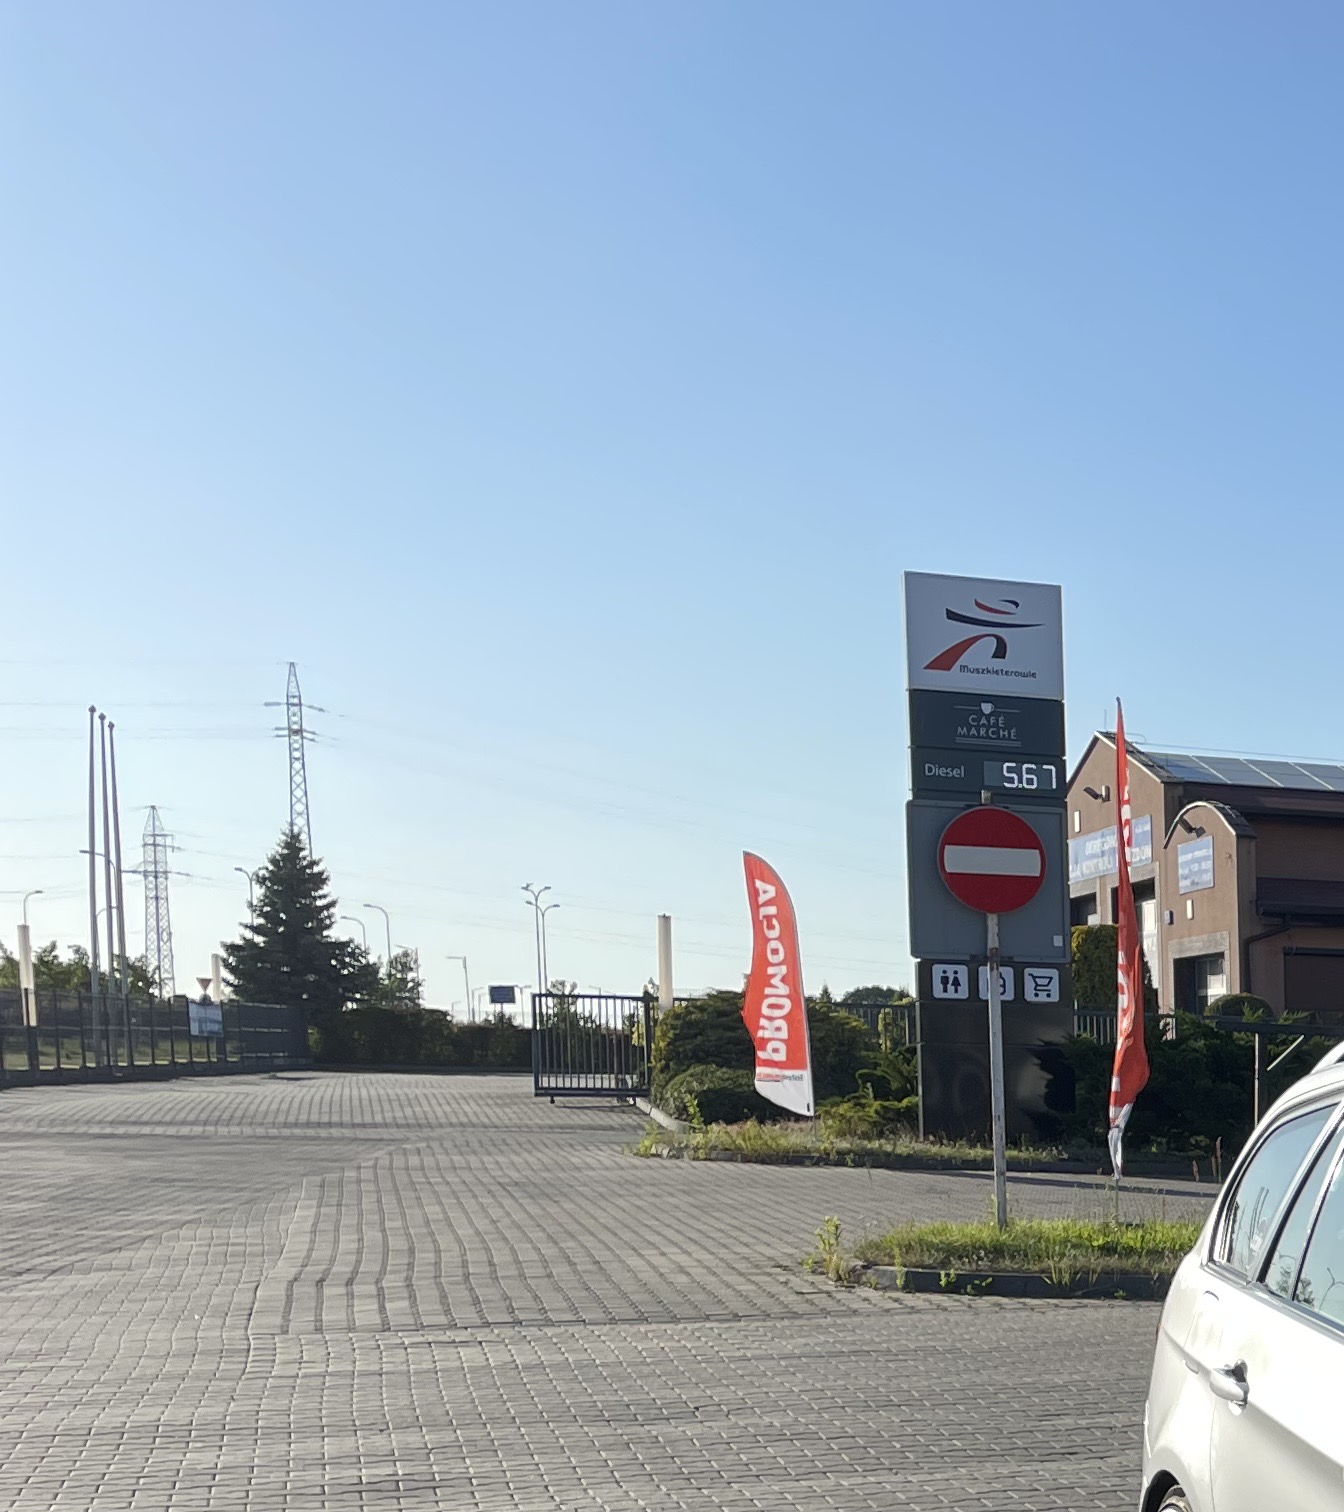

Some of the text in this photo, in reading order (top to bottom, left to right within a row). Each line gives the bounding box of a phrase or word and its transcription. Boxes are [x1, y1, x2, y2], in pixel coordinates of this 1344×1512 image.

[959, 664, 1037, 679] Muszkieterowie
[968, 714, 1005, 728] CAFÉ
[956, 726, 1018, 740] MARCHÉ
[924, 763, 965, 778] Diesel
